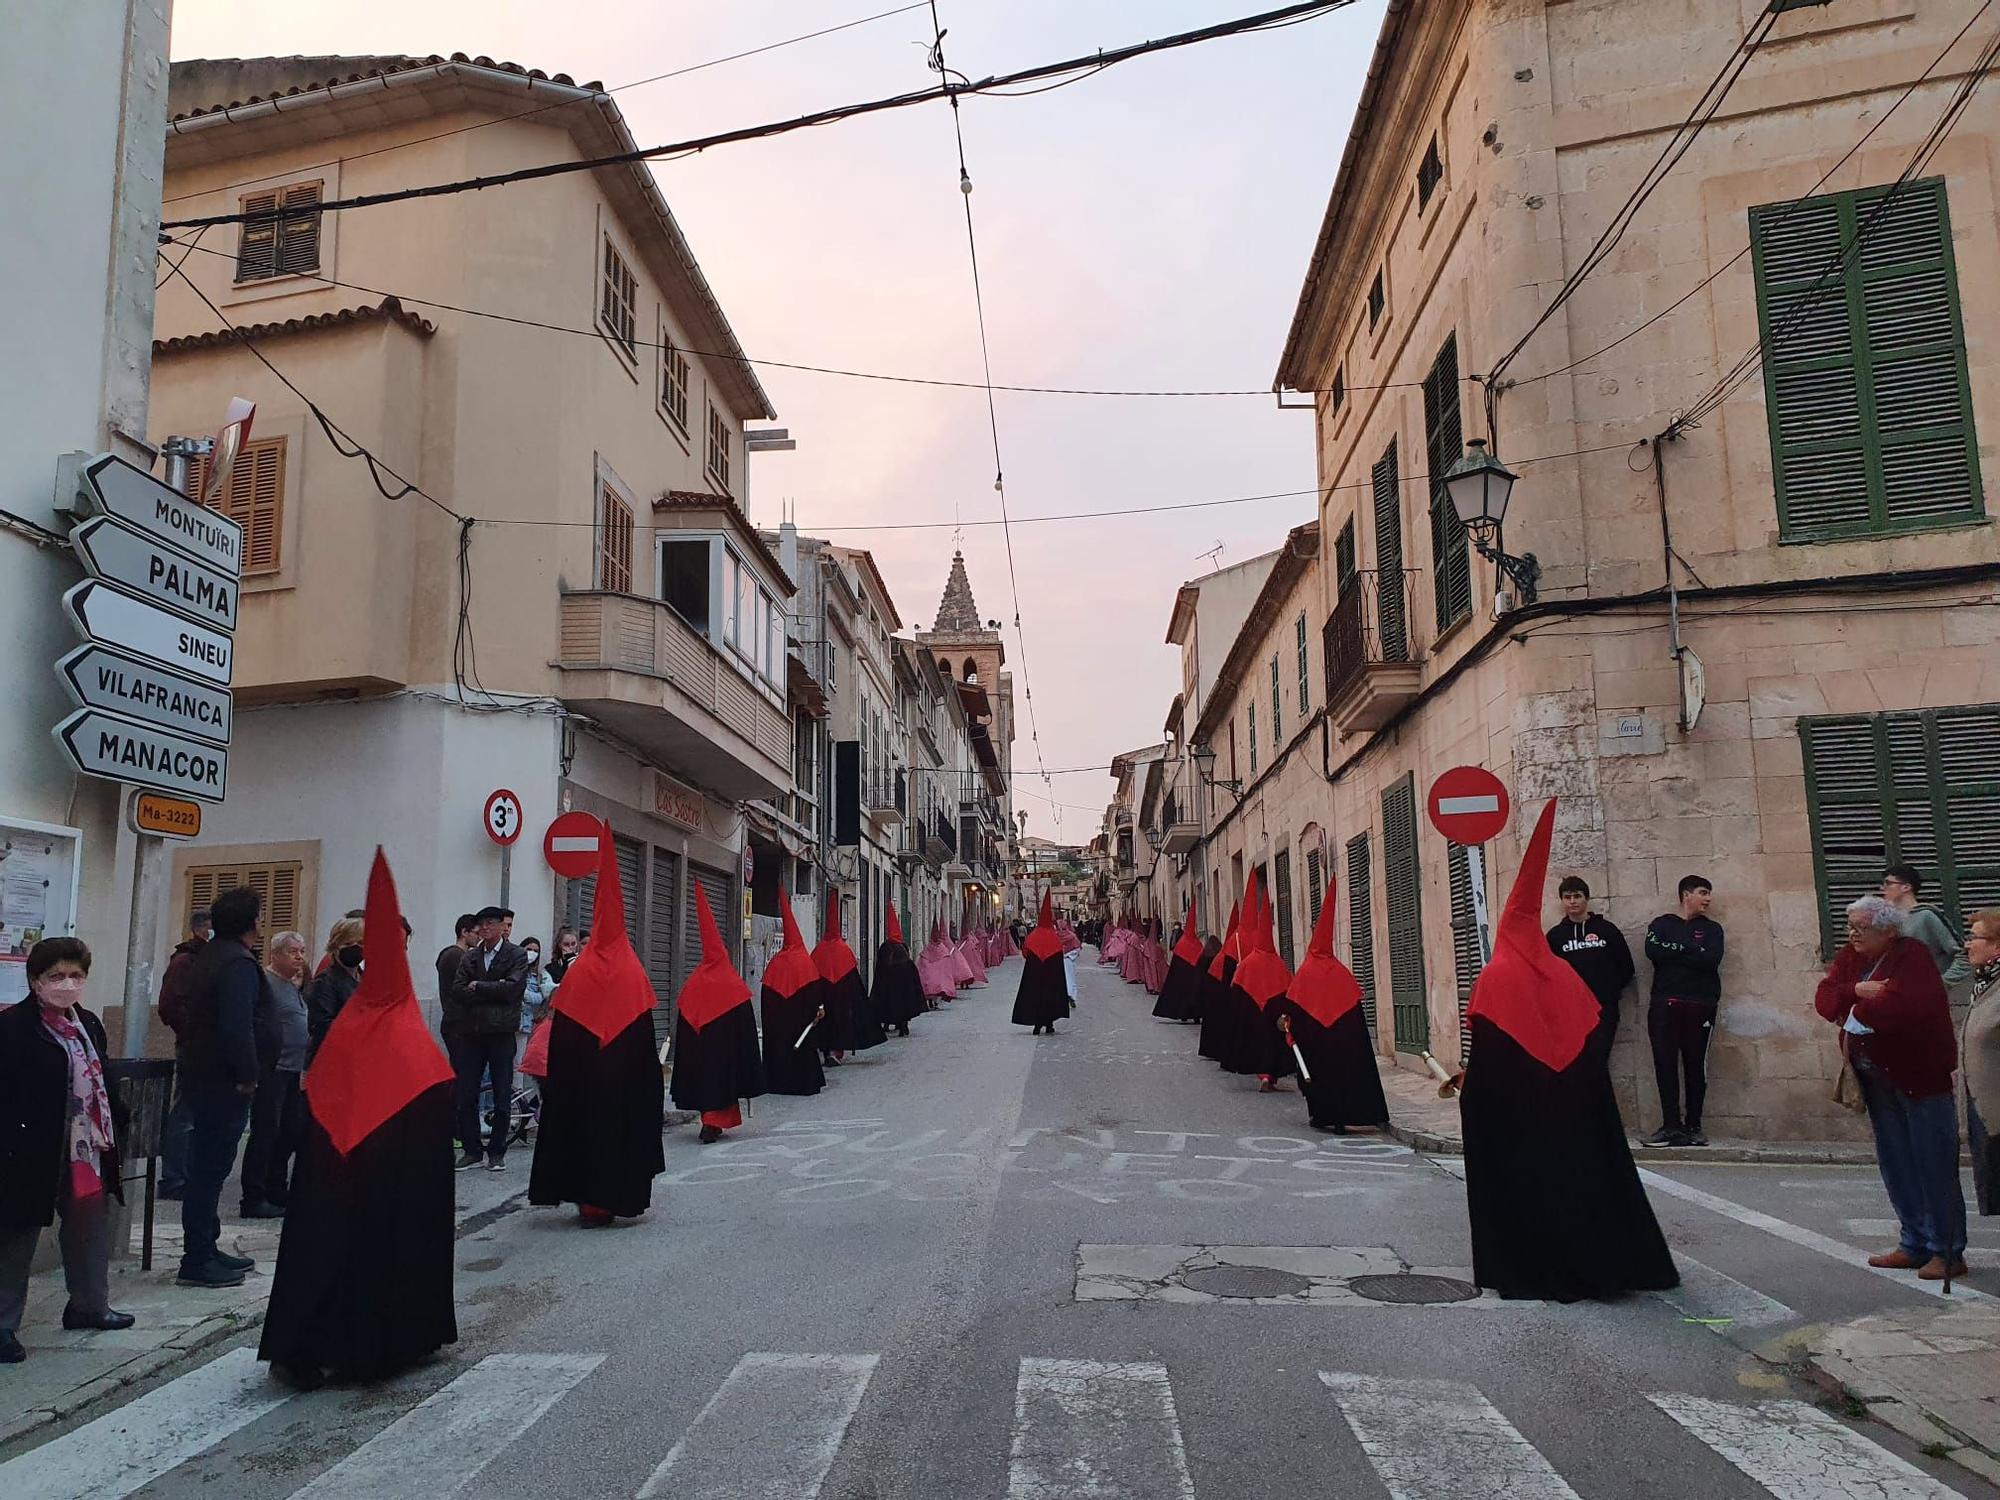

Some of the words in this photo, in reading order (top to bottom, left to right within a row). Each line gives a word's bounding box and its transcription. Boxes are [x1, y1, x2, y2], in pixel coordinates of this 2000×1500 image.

[155, 498, 235, 557] MONTUÏRI
[149, 554, 230, 617] PALMA
[178, 632, 227, 669] SINEU
[97, 666, 223, 728] VILAFRANCA
[98, 730, 219, 786] MANACOR
[142, 804, 196, 826] Ma-3222
[1562, 939, 1607, 952] ellesse
[702, 1128, 1416, 1160] QUINTOS
